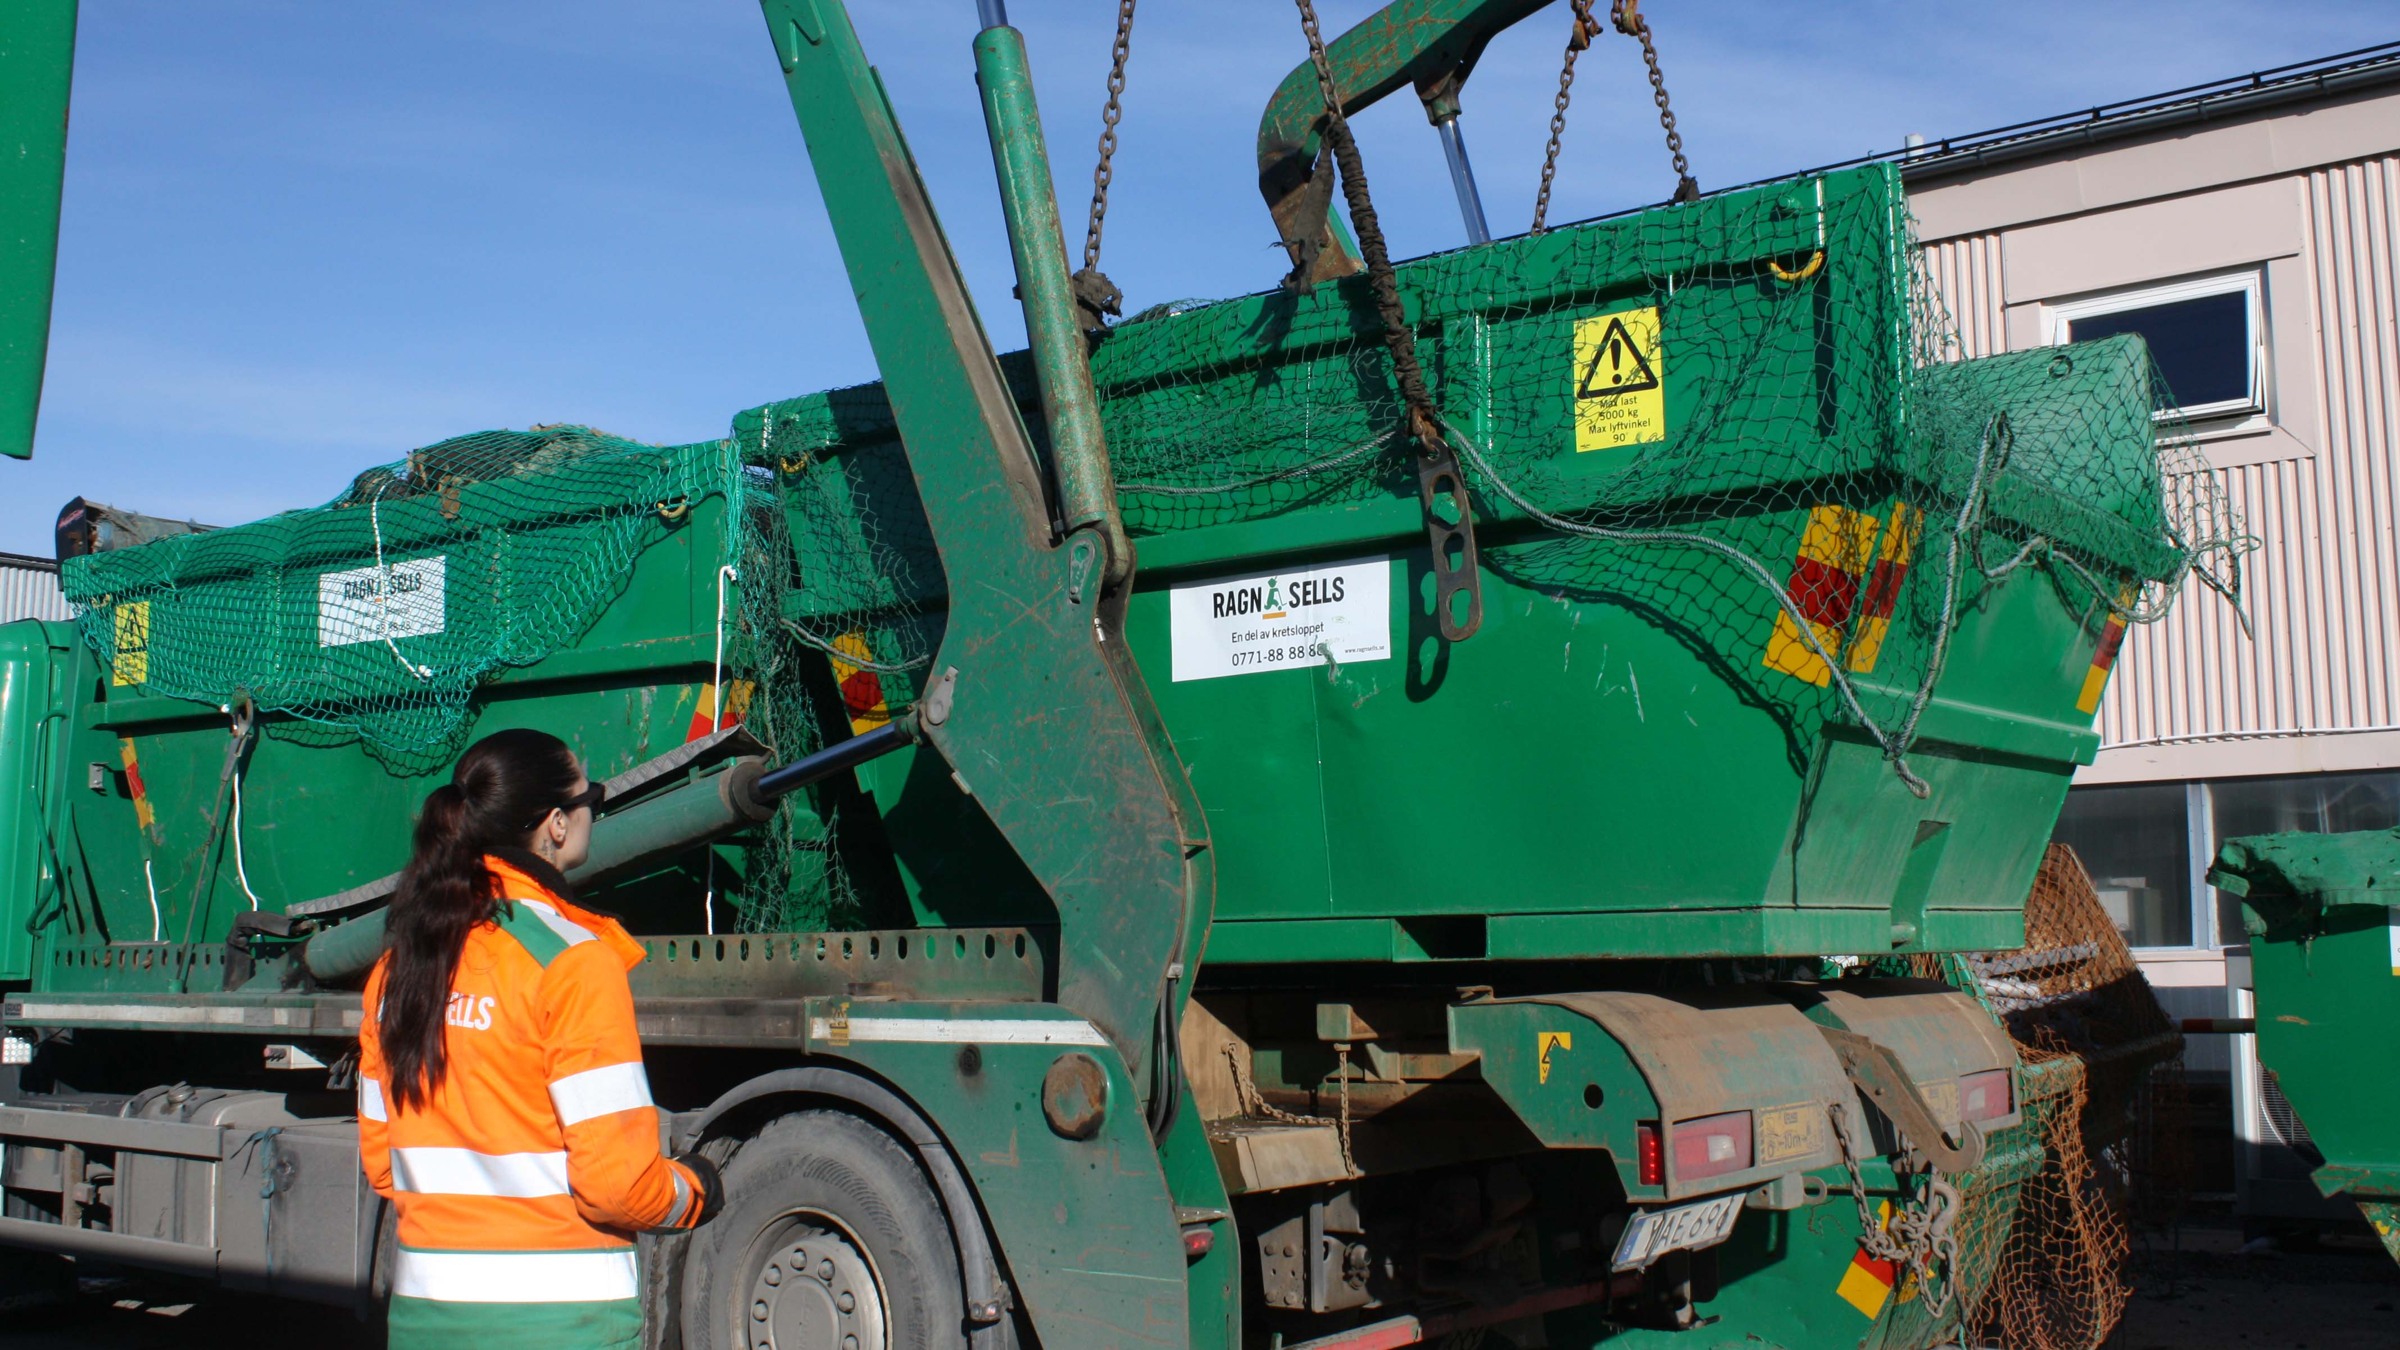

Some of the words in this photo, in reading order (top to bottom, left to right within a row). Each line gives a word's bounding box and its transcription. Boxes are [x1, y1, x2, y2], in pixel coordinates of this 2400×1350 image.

[1600, 399, 1618, 409] Max
[1621, 396, 1637, 406] last
[1599, 409, 1625, 421] 5000
[1628, 408, 1639, 418] kg
[1589, 424, 1607, 435] Max
[1610, 418, 1651, 433] lyftvinkel
[1213, 586, 1262, 619] RAGN
[1288, 576, 1345, 609] SELLS
[1231, 632, 1243, 643] En
[1244, 629, 1258, 642] del
[1260, 630, 1270, 640] av
[1272, 621, 1324, 638] kretsloppet
[1231, 648, 1284, 667] 0771-88
[1288, 646, 1305, 660] 88
[446, 991, 495, 1031] ELLS
